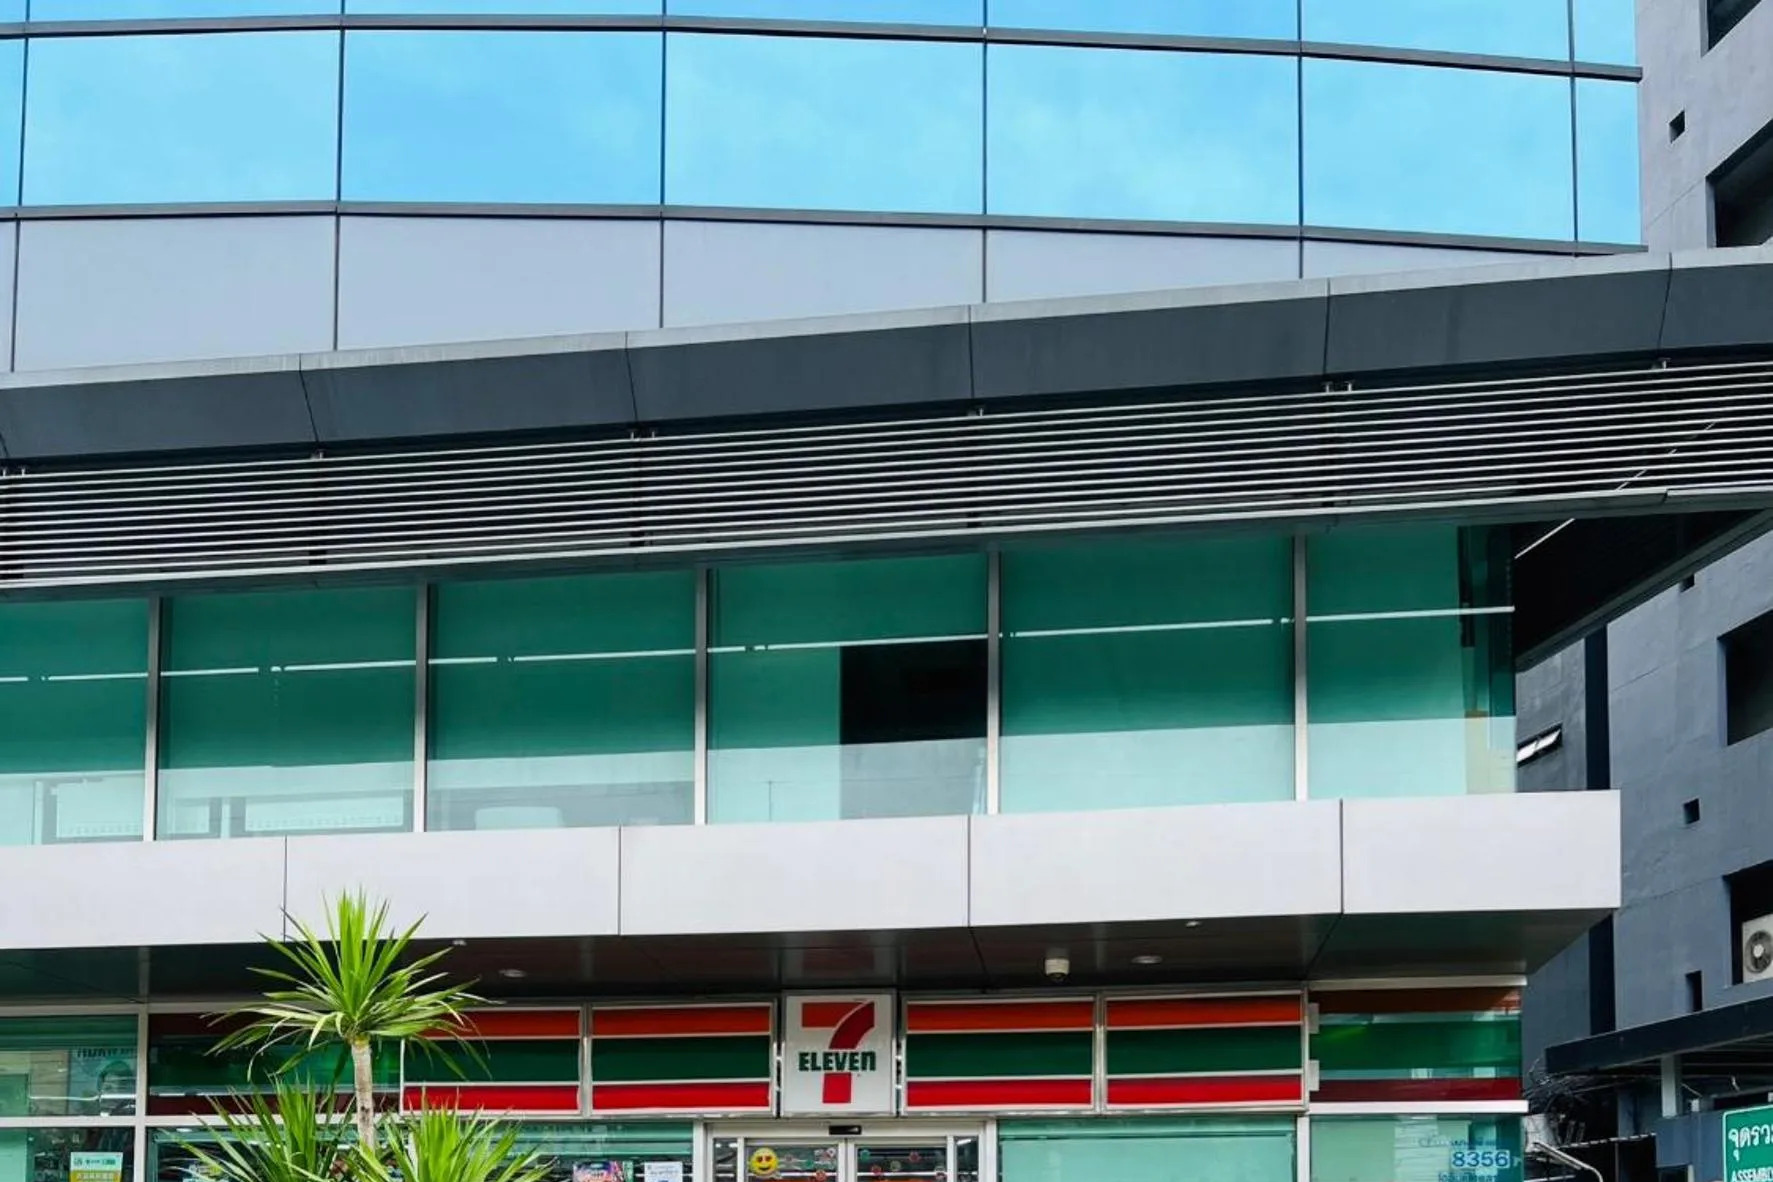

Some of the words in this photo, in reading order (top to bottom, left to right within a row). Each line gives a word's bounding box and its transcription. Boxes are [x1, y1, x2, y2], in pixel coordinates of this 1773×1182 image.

[802, 1001, 875, 1104] 7
[1452, 1151, 1509, 1168] 8356
[1728, 1124, 1773, 1161] จุดรว
